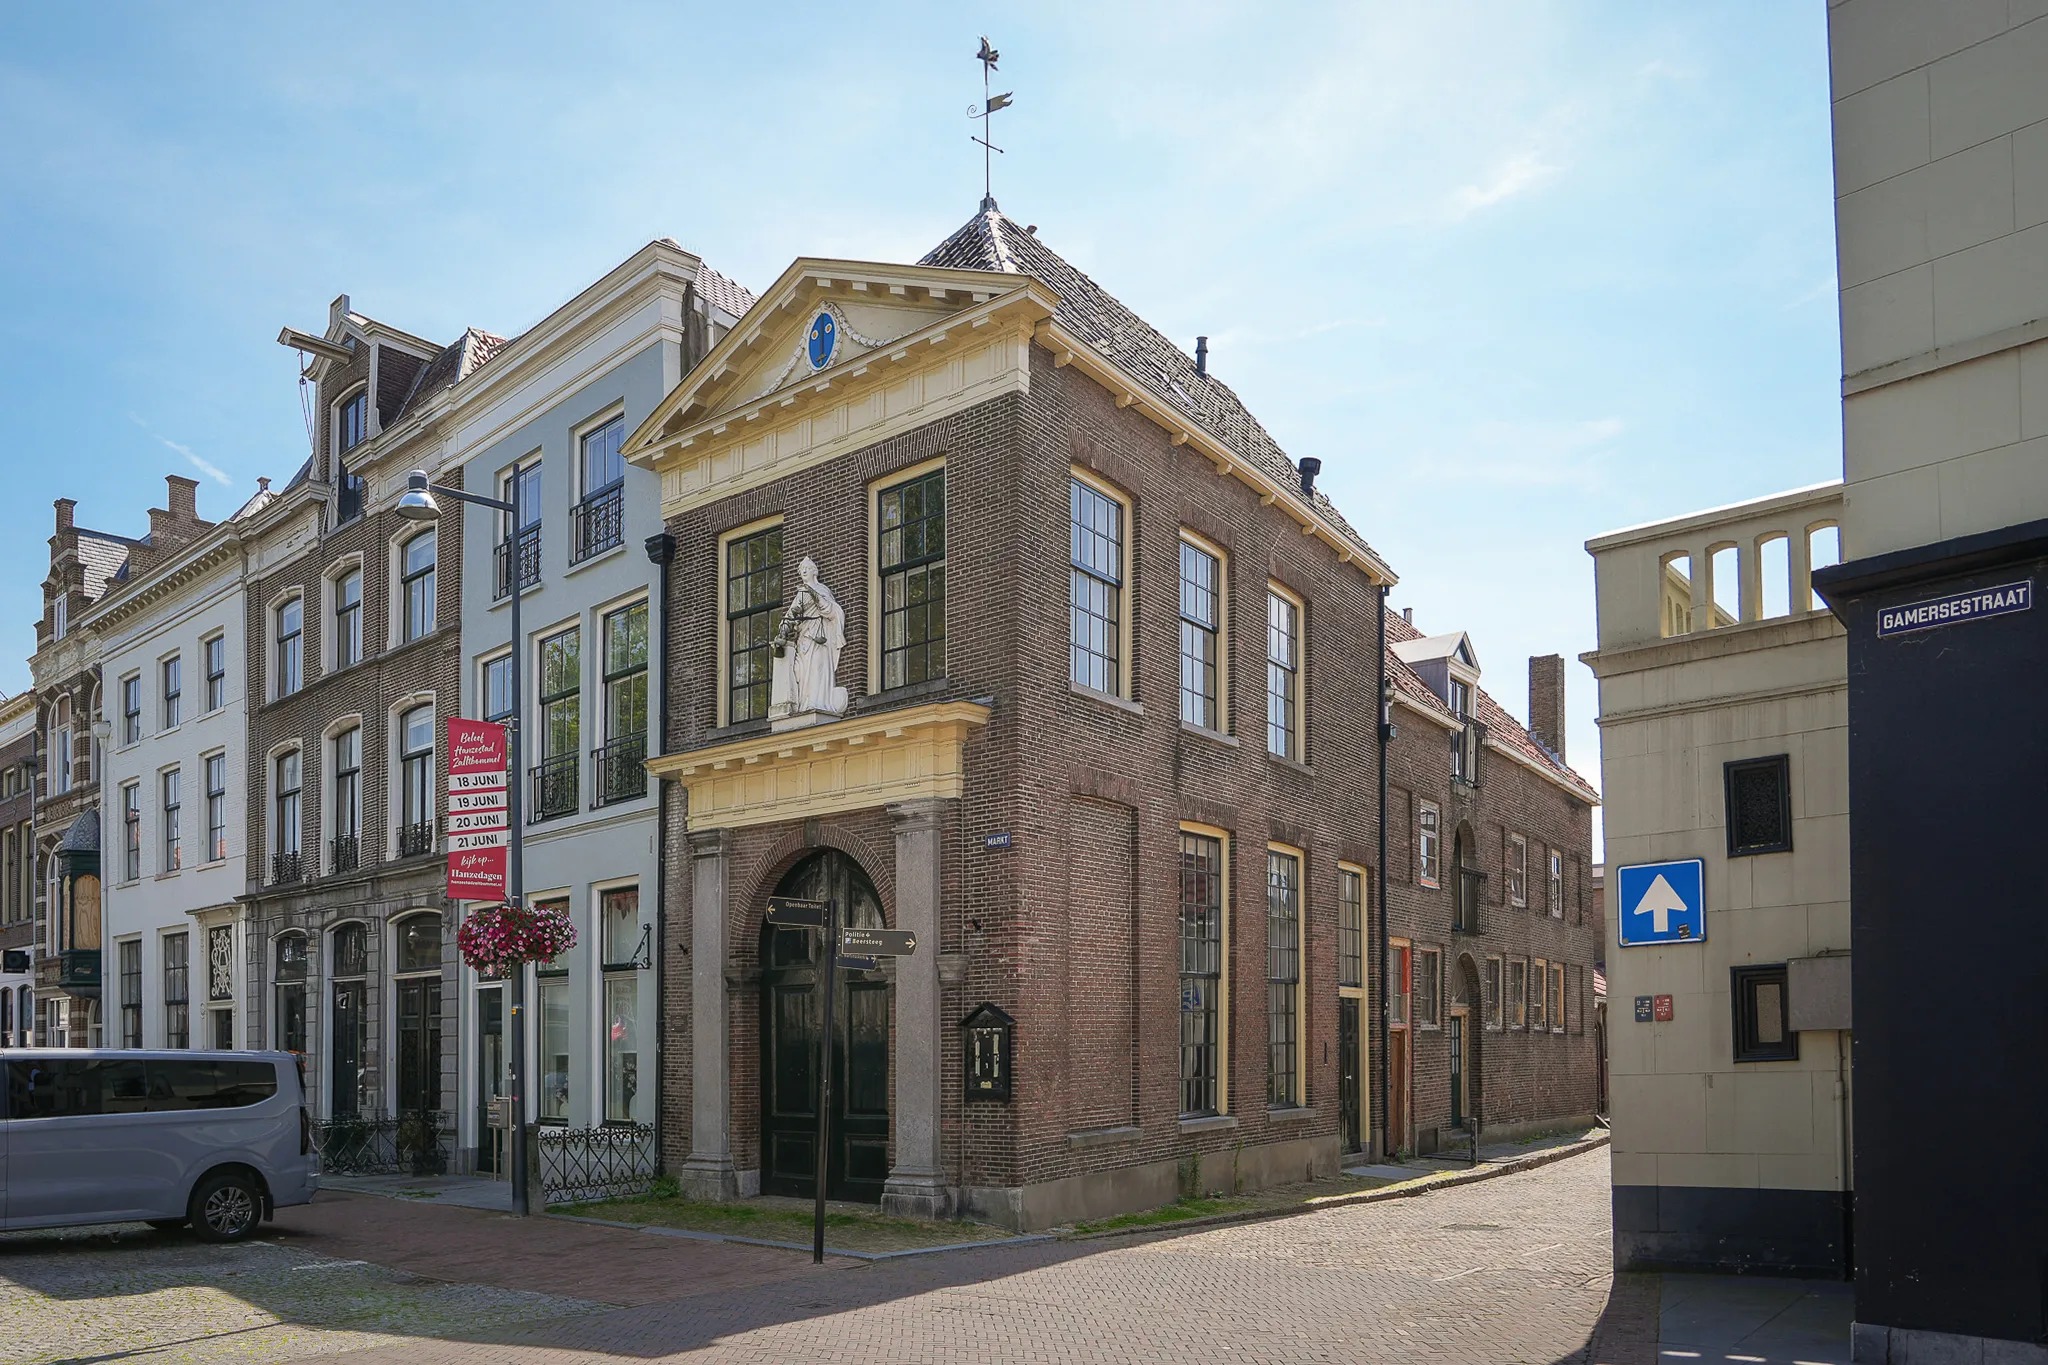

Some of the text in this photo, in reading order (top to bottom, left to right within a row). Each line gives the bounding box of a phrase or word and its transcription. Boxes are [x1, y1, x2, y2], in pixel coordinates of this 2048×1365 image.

[1883, 587, 2027, 630] GAMERSESTRAAT
[460, 732, 485, 744] Beleef
[454, 742, 495, 757] Hanzestad
[452, 752, 502, 769] Zaltbommel
[457, 774, 499, 788] 18 JUNI
[457, 795, 499, 808] 19 JUNI
[456, 814, 500, 828] 20 JUNI
[457, 834, 498, 848] 21 JUNI
[987, 835, 1008, 846] MARKT
[460, 854, 477, 869] kijk
[451, 869, 503, 882] Hanzedagen
[785, 901, 808, 909] Openbaar
[852, 938, 883, 946] Beersteeg
